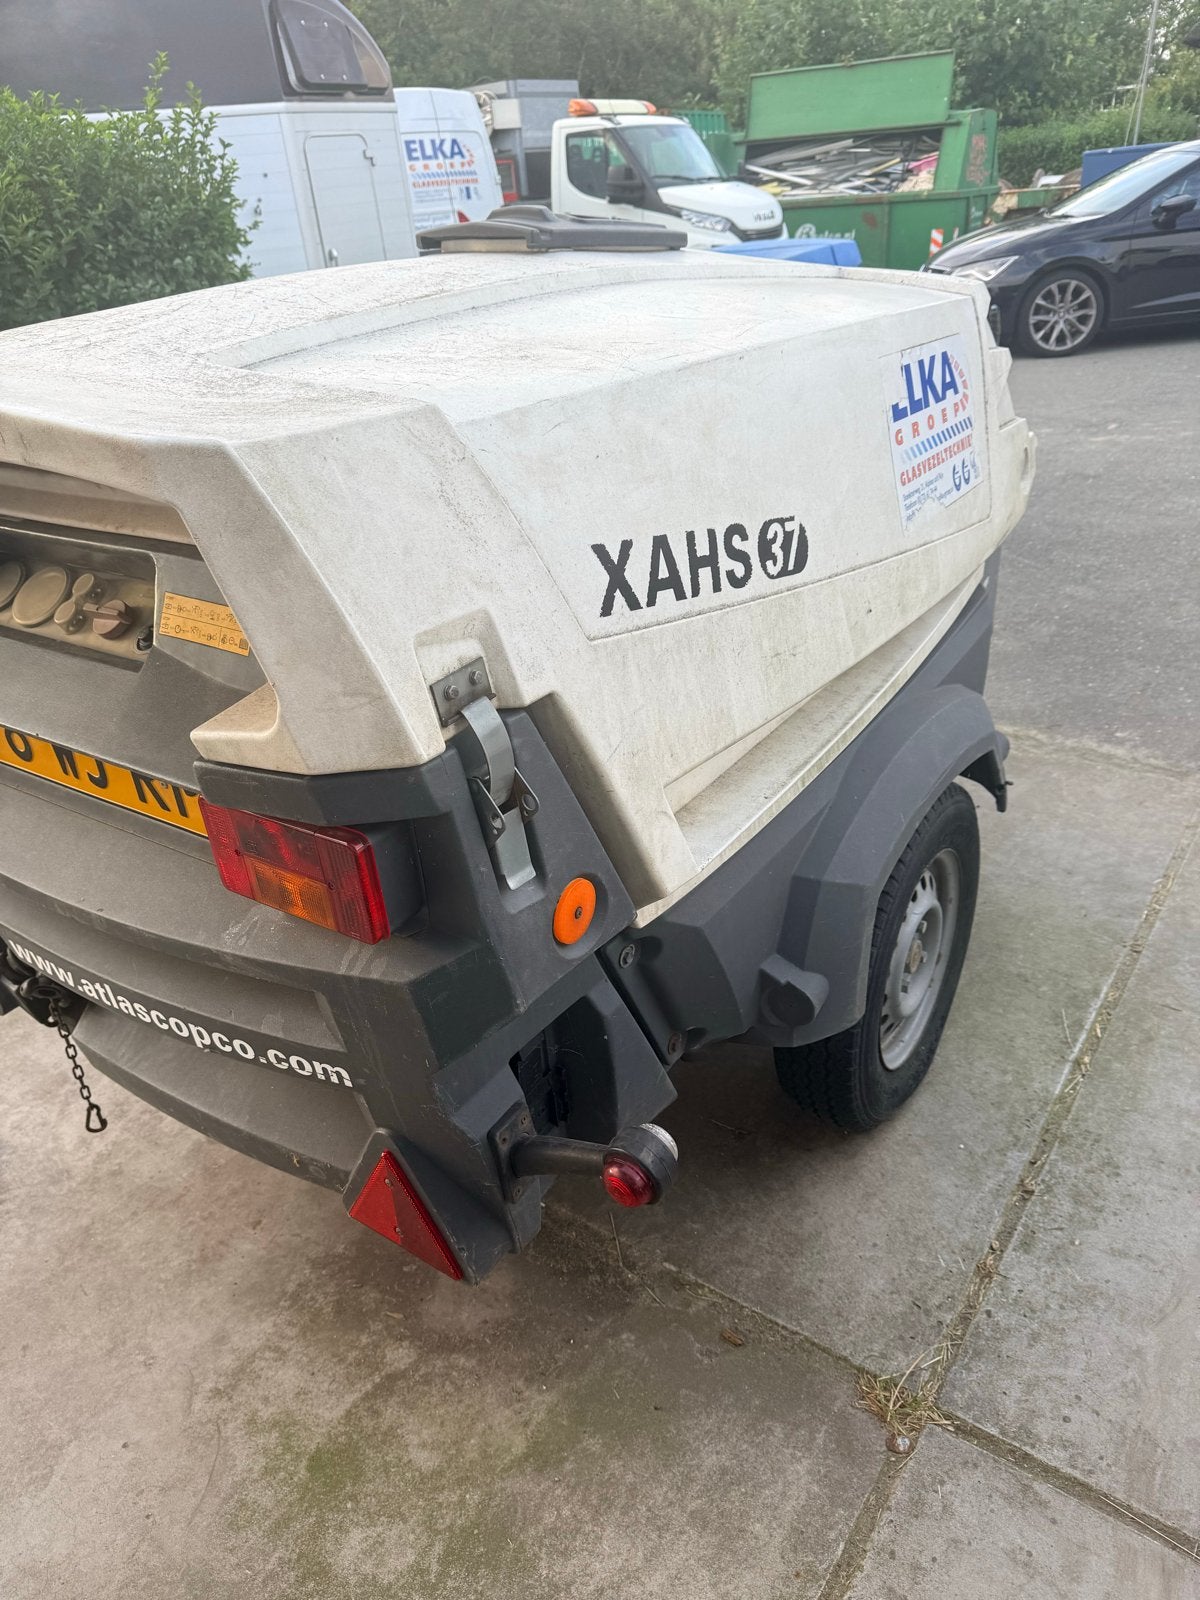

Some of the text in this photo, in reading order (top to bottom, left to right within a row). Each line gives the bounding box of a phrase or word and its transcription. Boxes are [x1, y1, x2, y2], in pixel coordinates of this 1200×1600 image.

[404, 138, 466, 161] ELKA
[894, 401, 961, 446] GROEP
[591, 522, 753, 617] XAHS
[8, 939, 353, 1088] www.atlascopco.com
